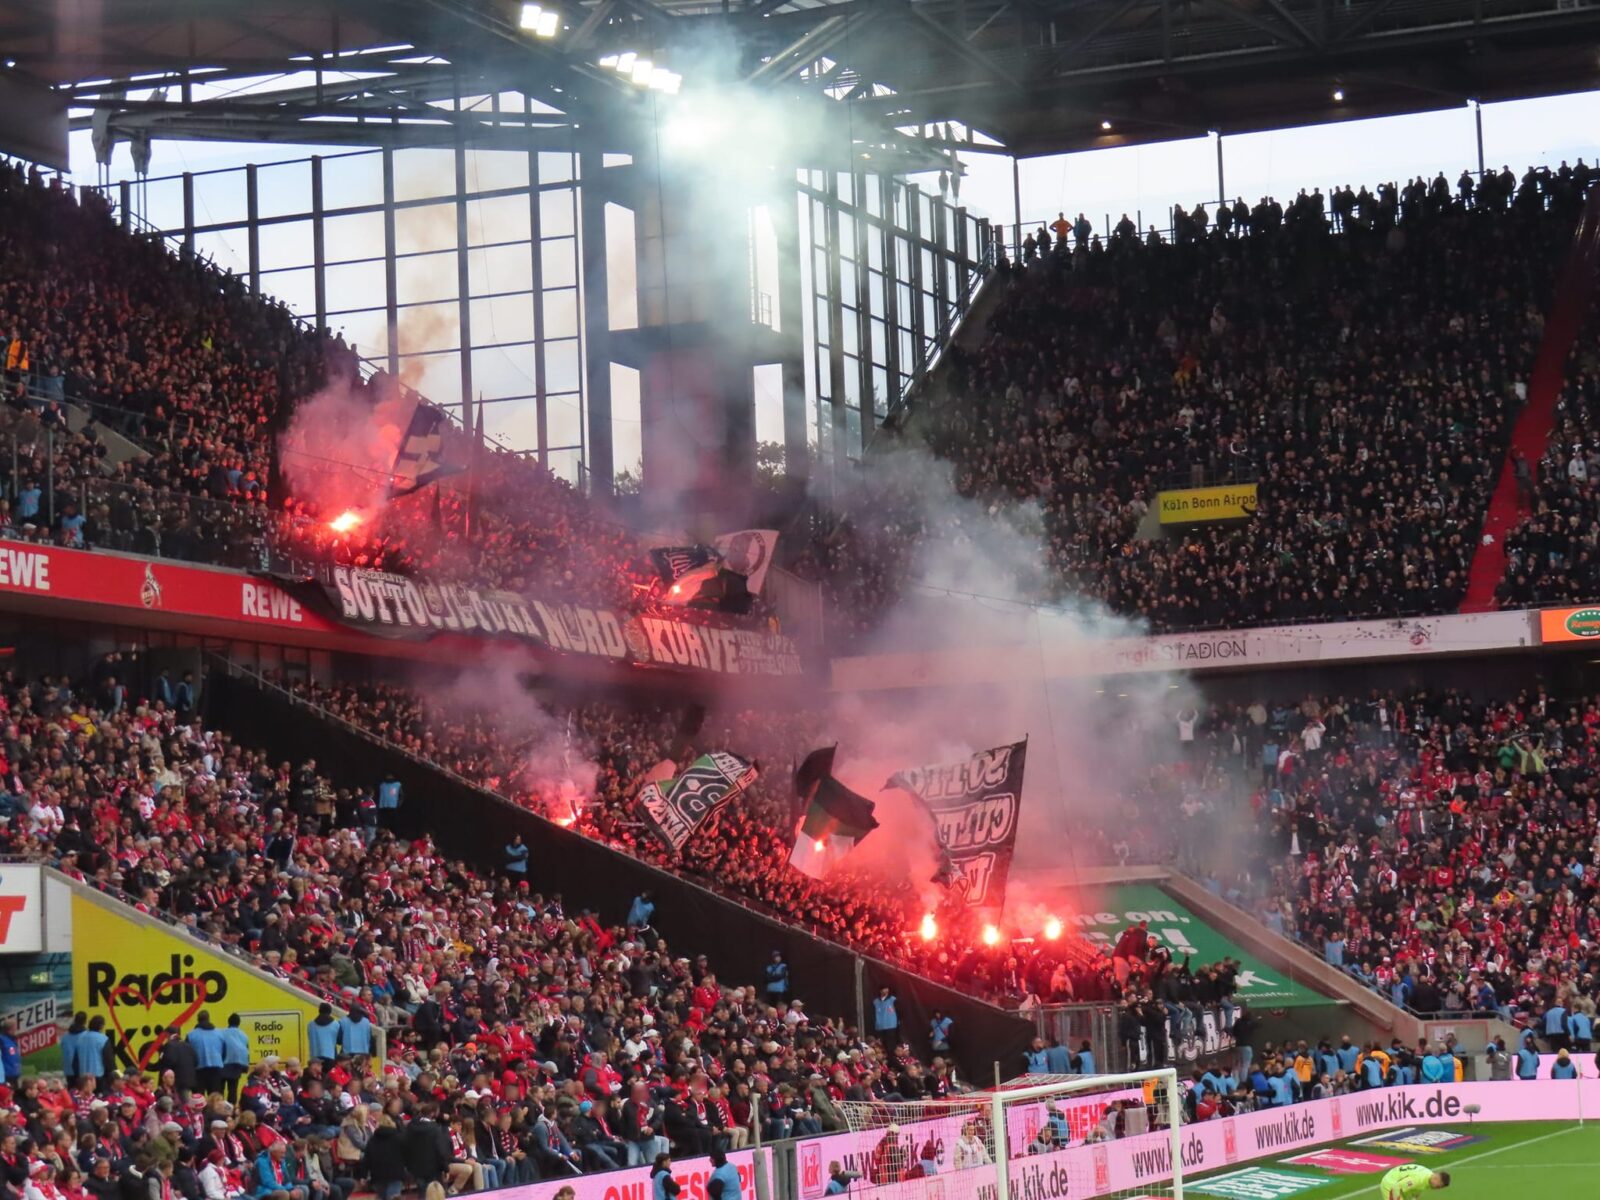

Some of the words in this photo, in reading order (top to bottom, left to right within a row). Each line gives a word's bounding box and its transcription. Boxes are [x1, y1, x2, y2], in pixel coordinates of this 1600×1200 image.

[1162, 498, 1189, 511] Köln
[1191, 497, 1220, 509] Bonn
[242, 582, 303, 622] REWE
[641, 616, 741, 674] KURVE
[88, 953, 228, 1008] Radio
[254, 1020, 284, 1032] Radio
[1355, 1089, 1461, 1127] www.kik.de
[1254, 1108, 1315, 1150] www.kik.de
[1132, 1131, 1204, 1178] www.kk.de
